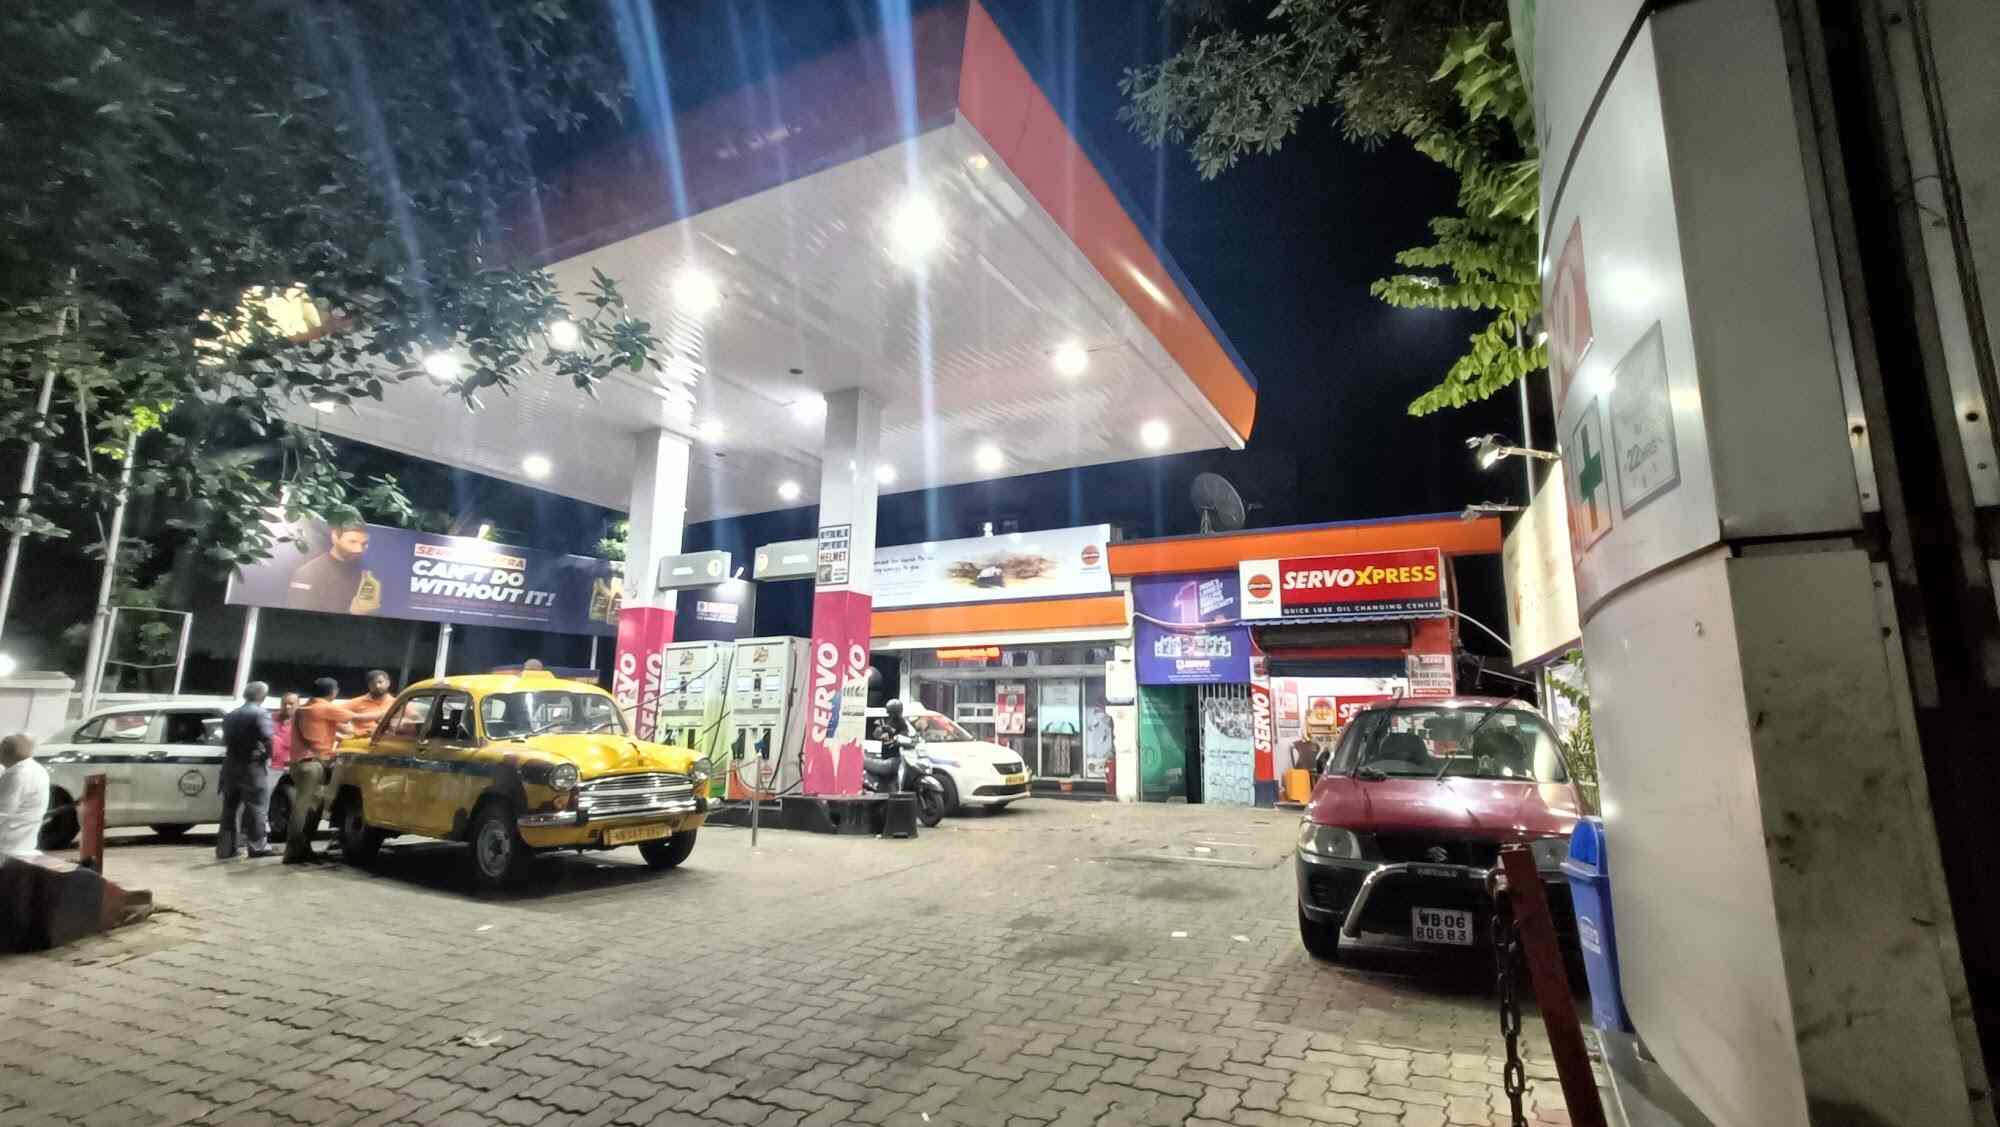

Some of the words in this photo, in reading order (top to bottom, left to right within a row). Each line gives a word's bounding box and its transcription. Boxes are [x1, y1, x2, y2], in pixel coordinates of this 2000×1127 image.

[489, 569, 525, 587] DO
[410, 576, 525, 602] WITHOUT
[524, 590, 556, 607] IT!
[1283, 607, 1310, 615] QUICK
[1354, 603, 1403, 613] CHANGING
[1406, 601, 1440, 610] CENTRE
[1252, 692, 1272, 753] SERVO
